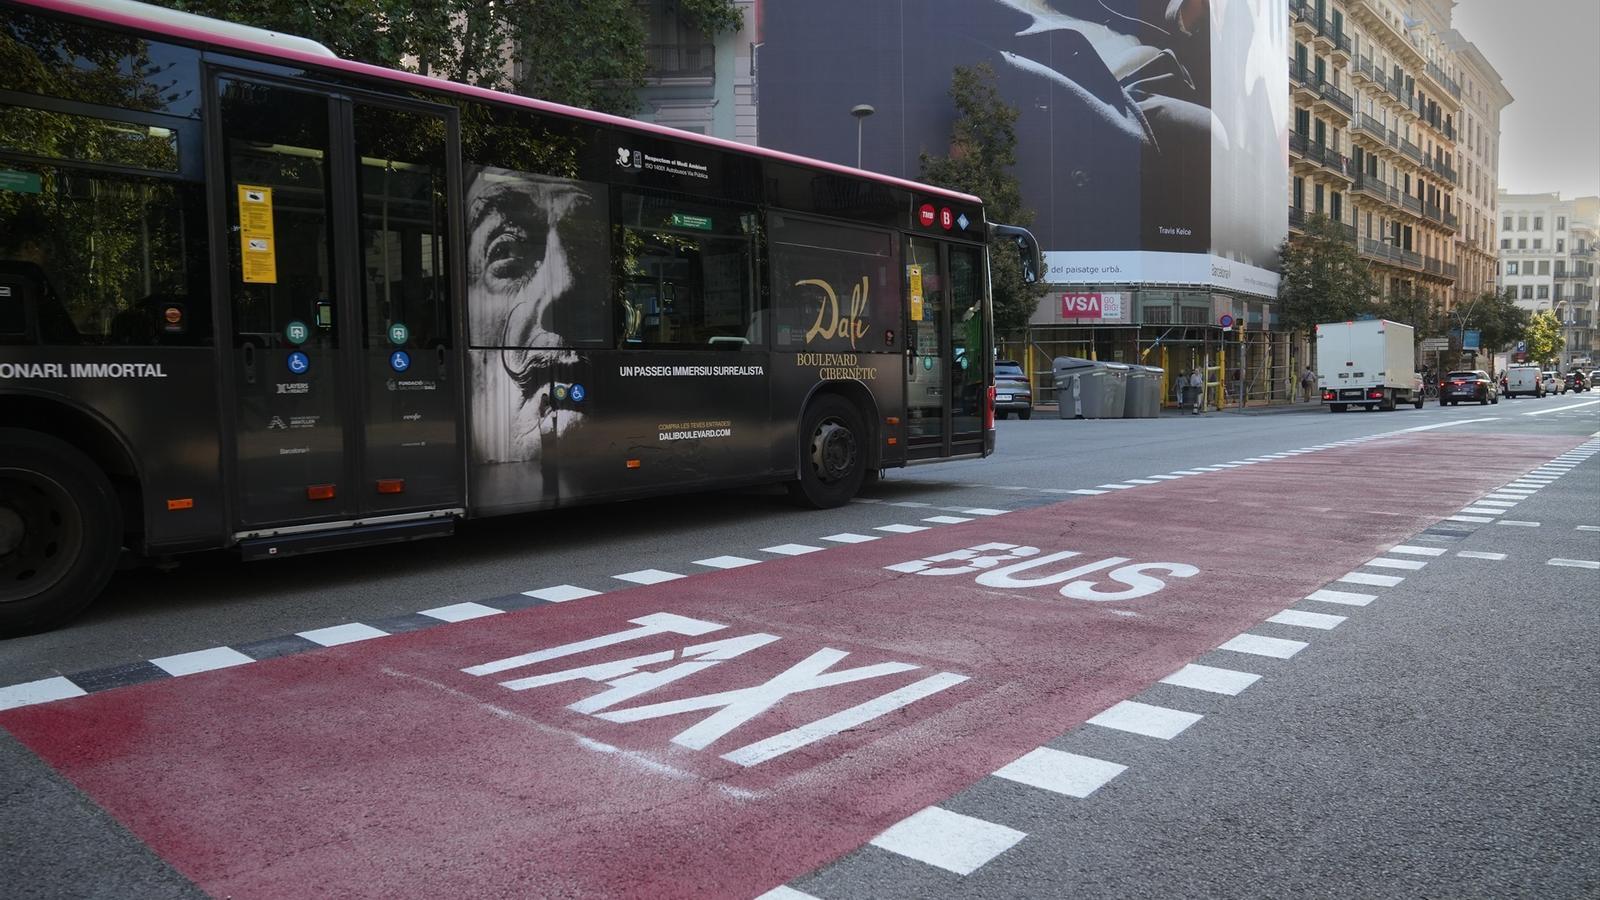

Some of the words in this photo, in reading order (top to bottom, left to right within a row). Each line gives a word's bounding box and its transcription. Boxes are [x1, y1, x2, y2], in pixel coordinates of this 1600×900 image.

[689, 163, 707, 171] Ambient
[922, 211, 934, 219] TMB
[943, 211, 951, 225] B
[1158, 226, 1175, 235] Travis
[1176, 228, 1192, 236] Kelce
[1051, 265, 1063, 273] del
[1065, 265, 1099, 275] paisatge
[1101, 265, 1122, 273] urbà.
[1064, 296, 1099, 311] VSA
[1103, 296, 1115, 304] GO
[794, 276, 870, 350] Dalí
[797, 353, 857, 366] BOULEVARD
[0, 363, 68, 379] ONARI.
[70, 363, 168, 378] IMMORTAL
[620, 366, 633, 376] UN
[634, 366, 671, 376] PASSEIG
[672, 366, 712, 376] IMMERSIU
[713, 366, 764, 376] SURREALISTA
[819, 364, 877, 380] CIBERNÈTIC
[659, 428, 731, 440] DALIBOULEVARD.COM
[883, 542, 1201, 601] BUS
[461, 612, 970, 767] TAXI
